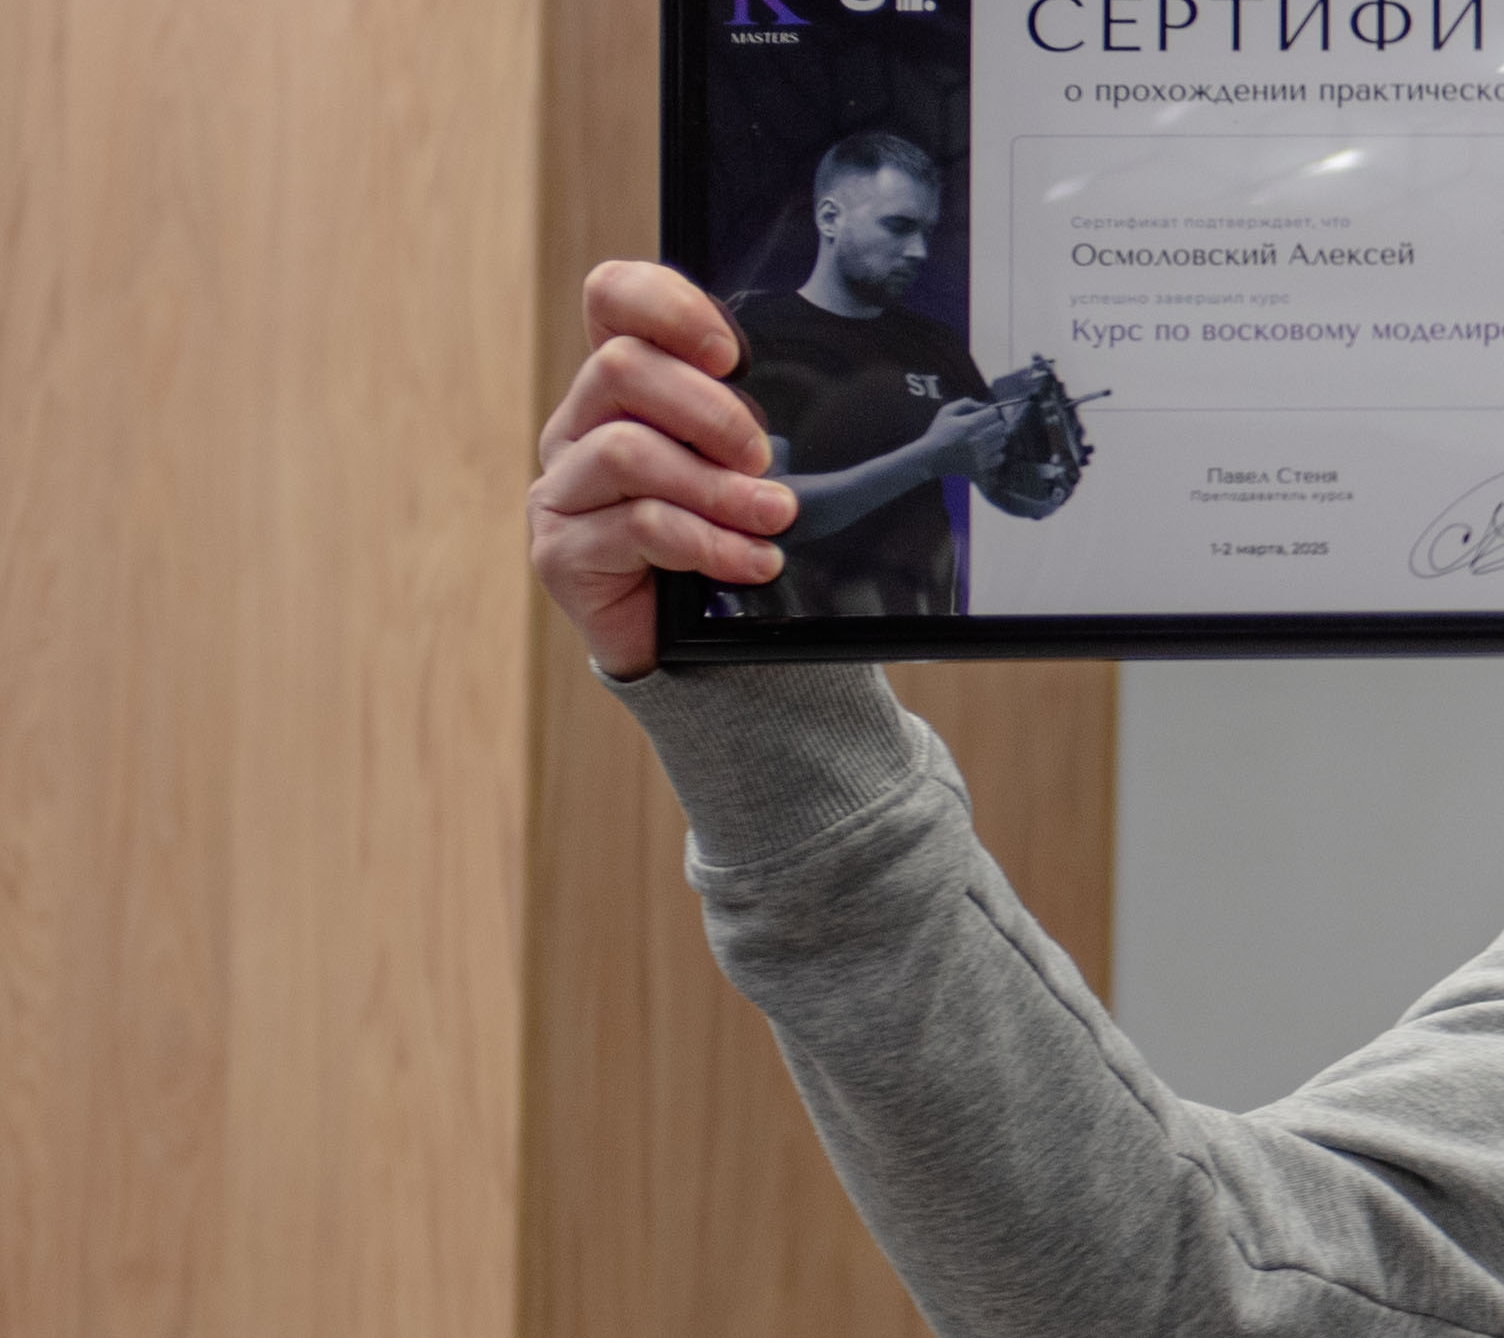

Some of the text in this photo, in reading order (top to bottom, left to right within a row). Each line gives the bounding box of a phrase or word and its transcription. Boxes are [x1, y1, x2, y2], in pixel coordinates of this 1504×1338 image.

[731, 31, 800, 45] MASTERS
[1064, 84, 1082, 102] о
[1095, 82, 1307, 108] прохождении
[1070, 215, 1178, 231] Сертификат
[1321, 216, 1351, 228] что
[1071, 242, 1415, 267] Осмоловский Алексей
[1069, 293, 1148, 307] успешно
[1249, 293, 1290, 306] курс
[1071, 319, 1143, 348] Курс
[1154, 322, 1190, 343] по
[1201, 322, 1361, 348] восковому
[1206, 466, 1270, 484] Павел
